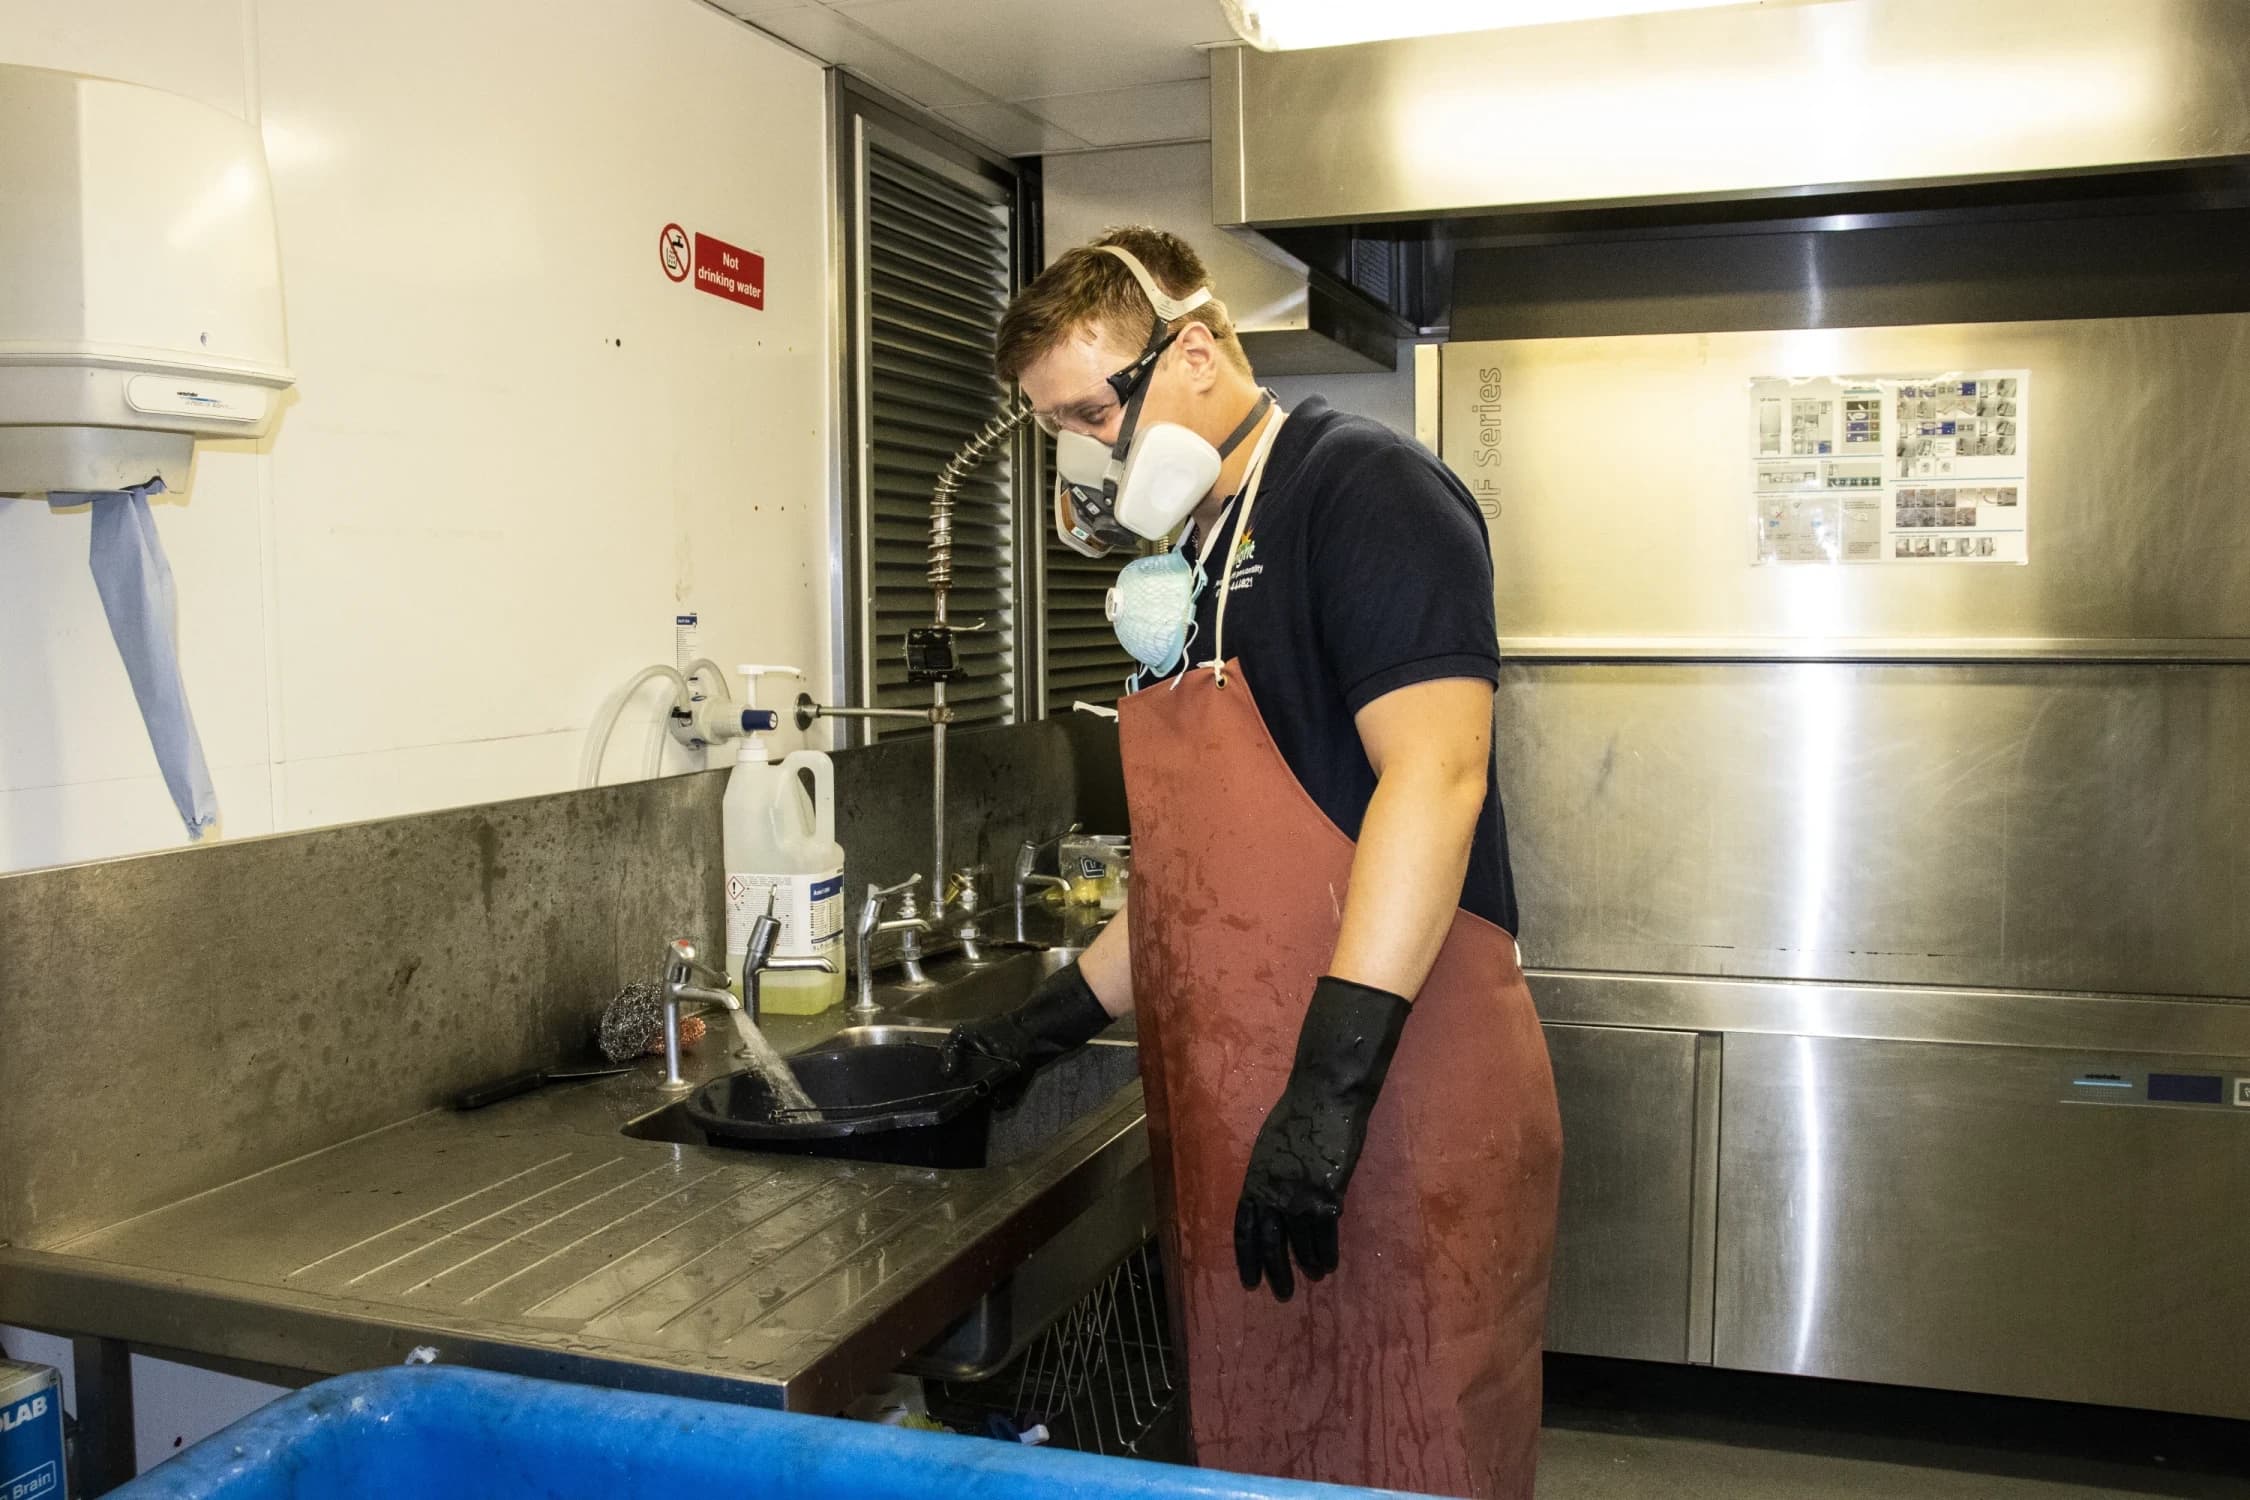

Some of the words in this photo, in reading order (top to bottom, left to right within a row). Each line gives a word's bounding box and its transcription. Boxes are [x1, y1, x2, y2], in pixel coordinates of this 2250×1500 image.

[723, 252, 739, 270] Not
[698, 266, 735, 292] drinking
[736, 281, 761, 299] water
[1472, 367, 1502, 467] Series
[13, 1472, 51, 1499] Brain
